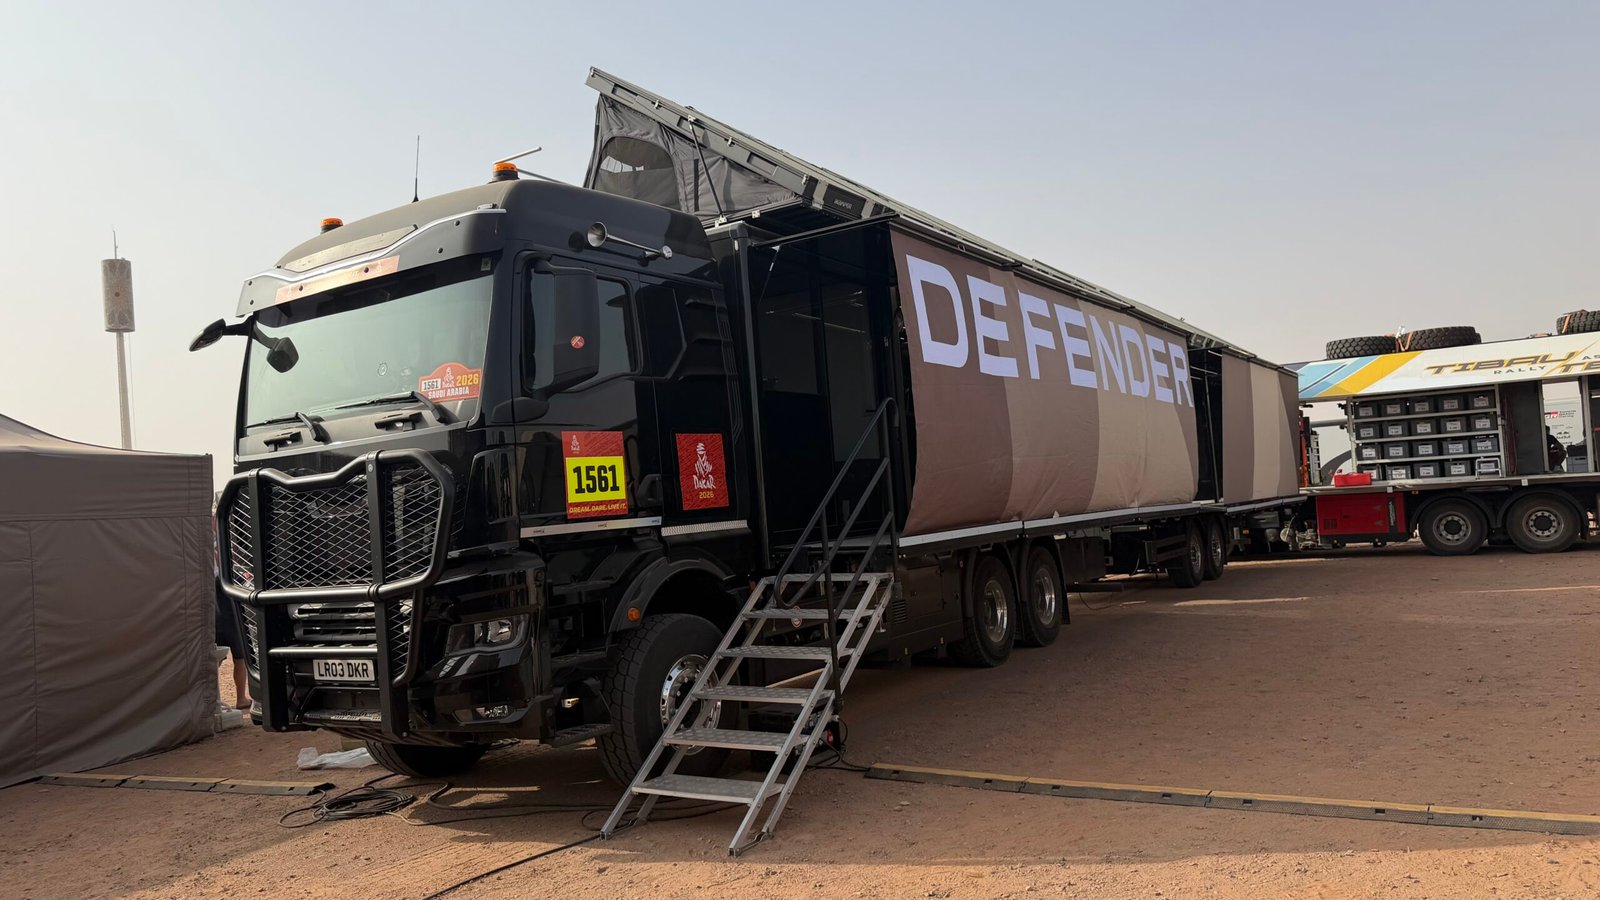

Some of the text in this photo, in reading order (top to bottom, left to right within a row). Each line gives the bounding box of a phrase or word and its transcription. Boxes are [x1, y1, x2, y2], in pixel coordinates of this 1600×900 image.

[905, 254, 1194, 408] DEFENDER
[1493, 365, 1547, 375] RALLY
[424, 380, 438, 390] 1561
[456, 374, 479, 386] 2026
[428, 387, 469, 399] SAUDI ARABIA
[573, 465, 620, 494] 1561
[698, 490, 715, 499] 2026
[318, 662, 369, 678] LR03 DKR
